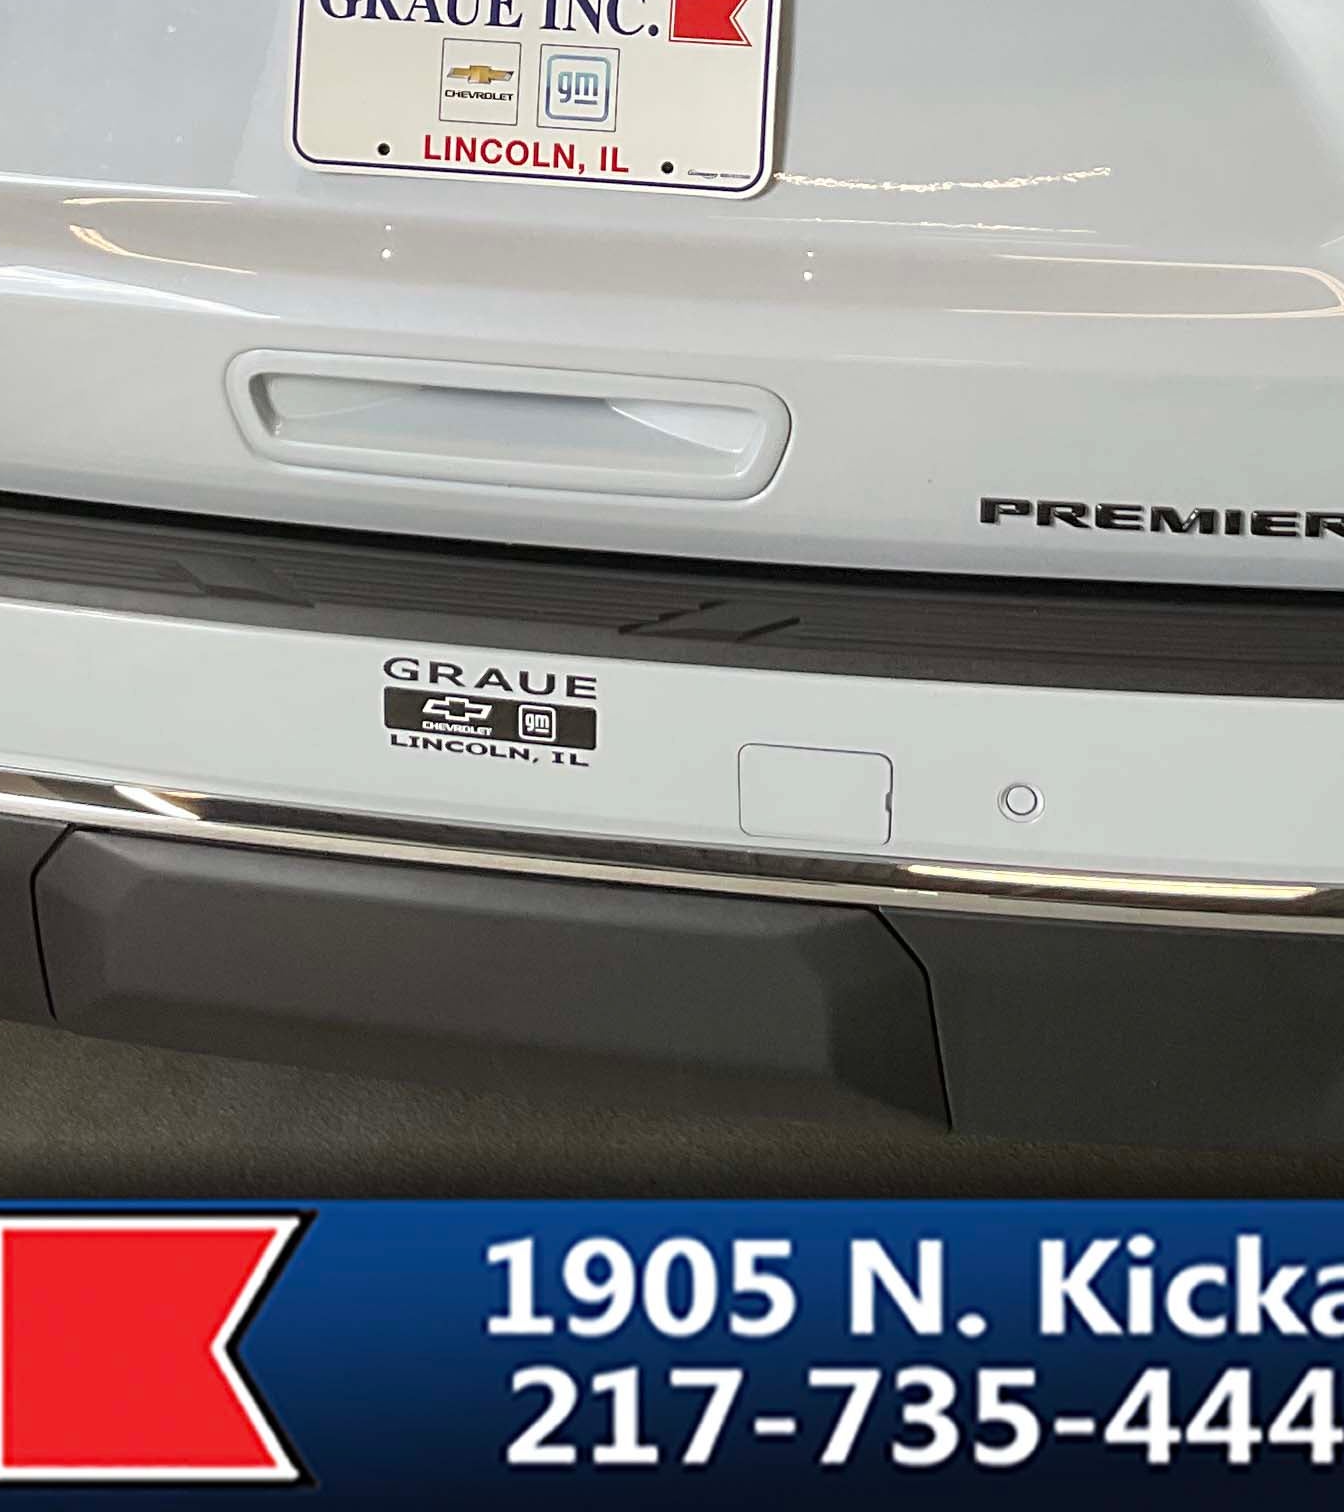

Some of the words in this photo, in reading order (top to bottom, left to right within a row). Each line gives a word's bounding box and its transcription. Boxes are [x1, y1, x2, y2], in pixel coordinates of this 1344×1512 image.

[444, 89, 514, 102] CHEVROLET
[557, 71, 599, 105] gm
[424, 134, 586, 175] LINCOLN,
[600, 146, 630, 173] IL
[383, 656, 598, 700] GRAUE
[422, 719, 493, 737] CHEVROLET
[525, 712, 551, 734] gm
[389, 733, 539, 764] LINCOLN,
[551, 750, 590, 767] IL
